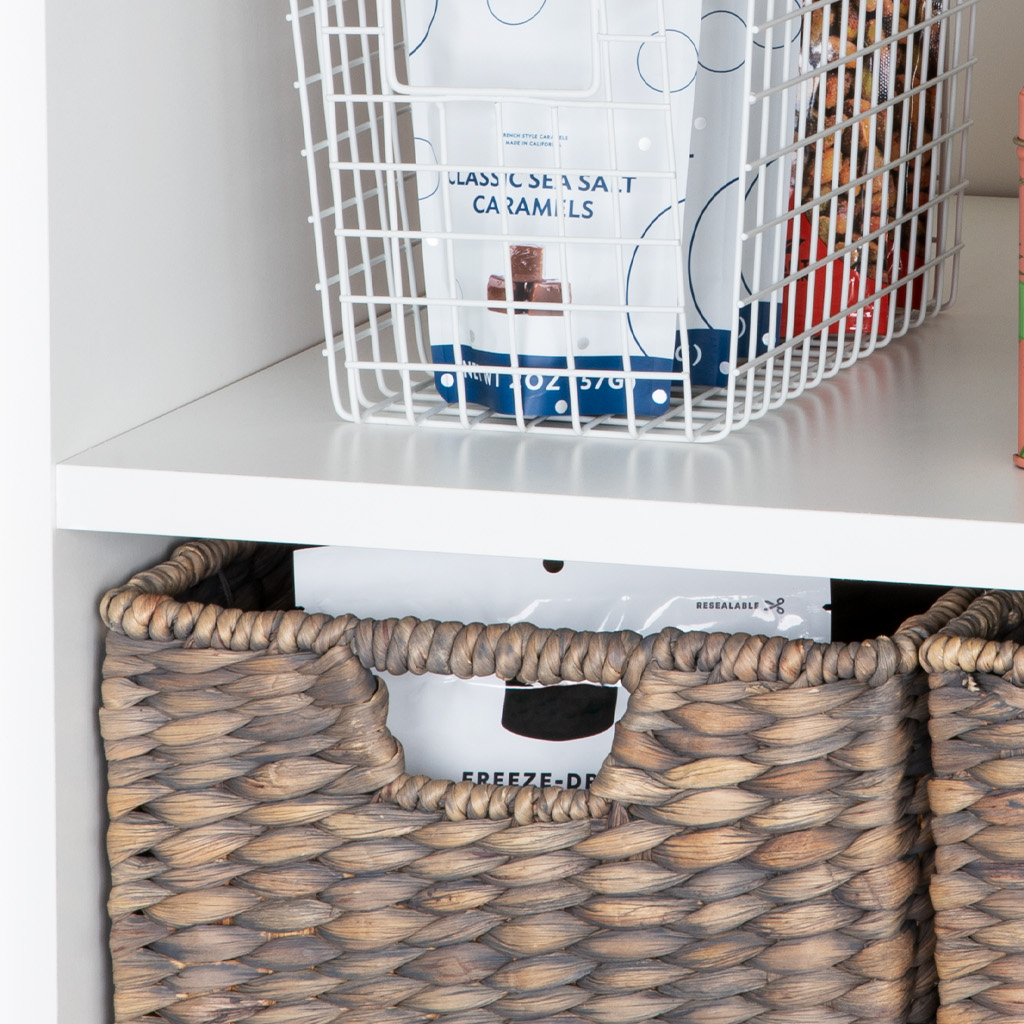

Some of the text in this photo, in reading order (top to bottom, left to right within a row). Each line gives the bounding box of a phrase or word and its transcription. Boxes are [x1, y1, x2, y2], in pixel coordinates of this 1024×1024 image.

[528, 173, 572, 191] SEA
[577, 175, 637, 193] SAT
[472, 194, 594, 220] CARAMLS
[510, 373, 561, 391] OZ
[696, 601, 760, 610] RESEALABLE
